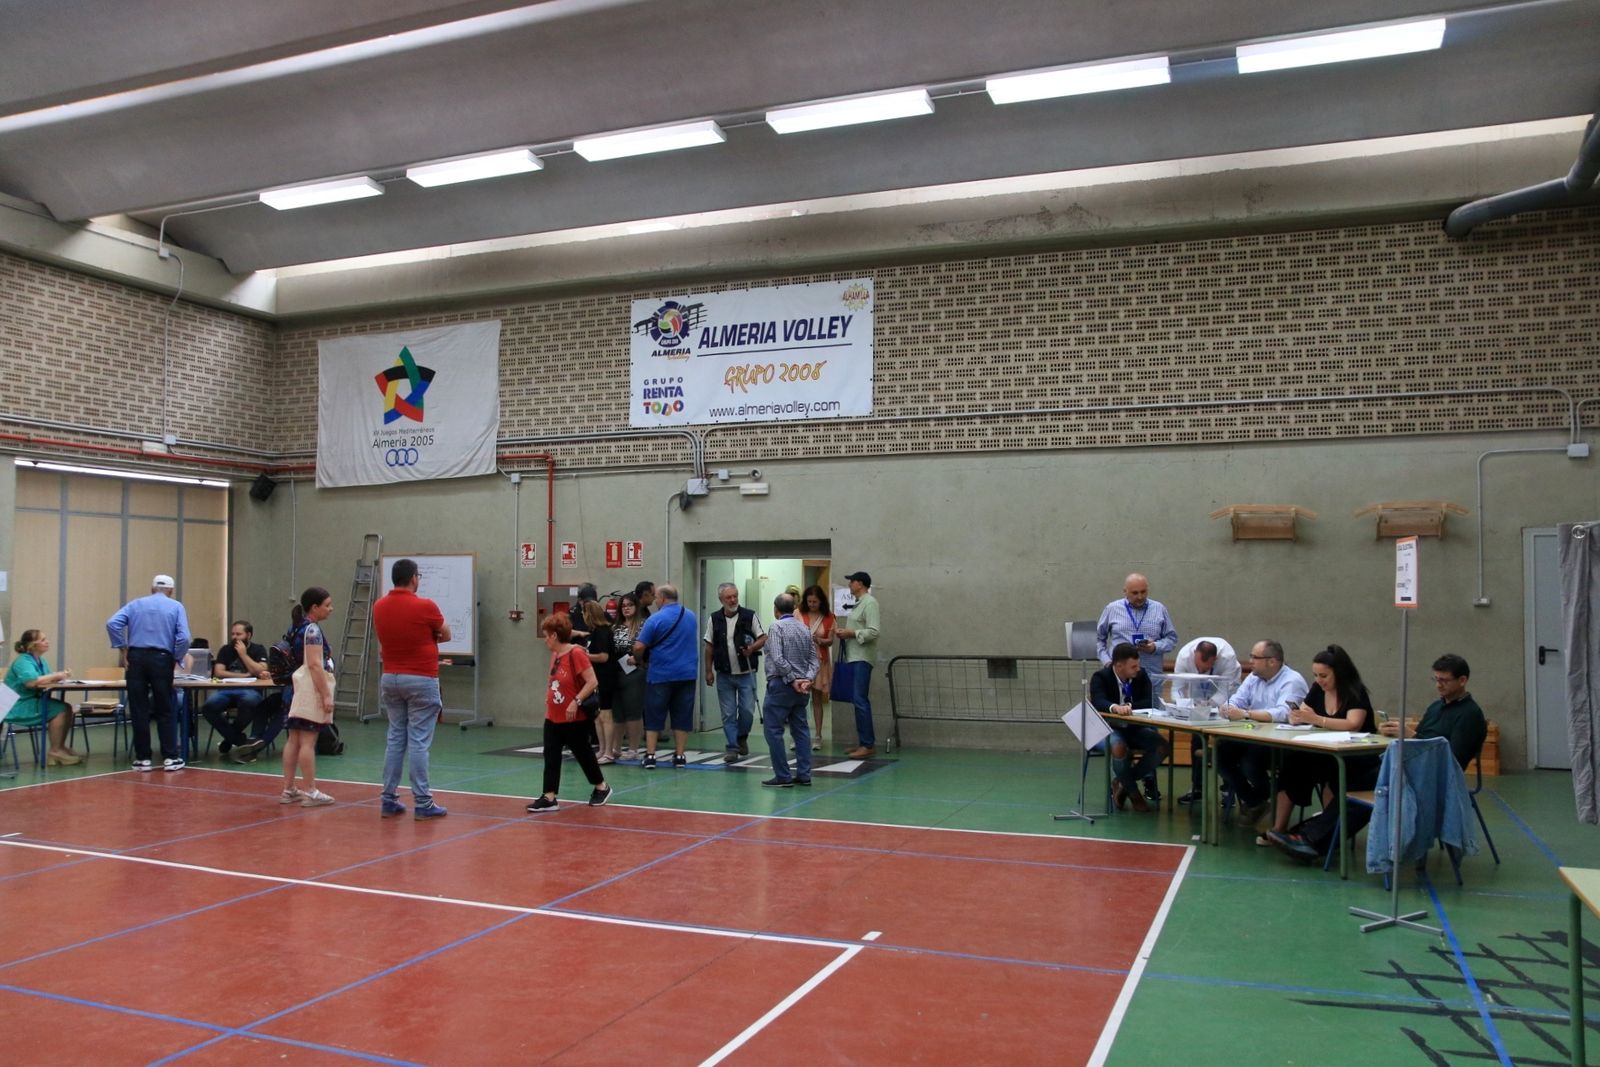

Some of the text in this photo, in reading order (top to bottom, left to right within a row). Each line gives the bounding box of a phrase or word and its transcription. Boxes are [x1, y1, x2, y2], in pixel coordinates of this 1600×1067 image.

[698, 315, 853, 349] ALMERIA VOLLEY
[651, 348, 691, 357] ALMERIA
[643, 376, 684, 386] GRUPO
[724, 363, 775, 394] GRUPO
[643, 385, 684, 399] RENTA
[643, 400, 684, 416] TODO
[709, 400, 840, 417] www.almeriavolley.com
[410, 434, 434, 446] 2005
